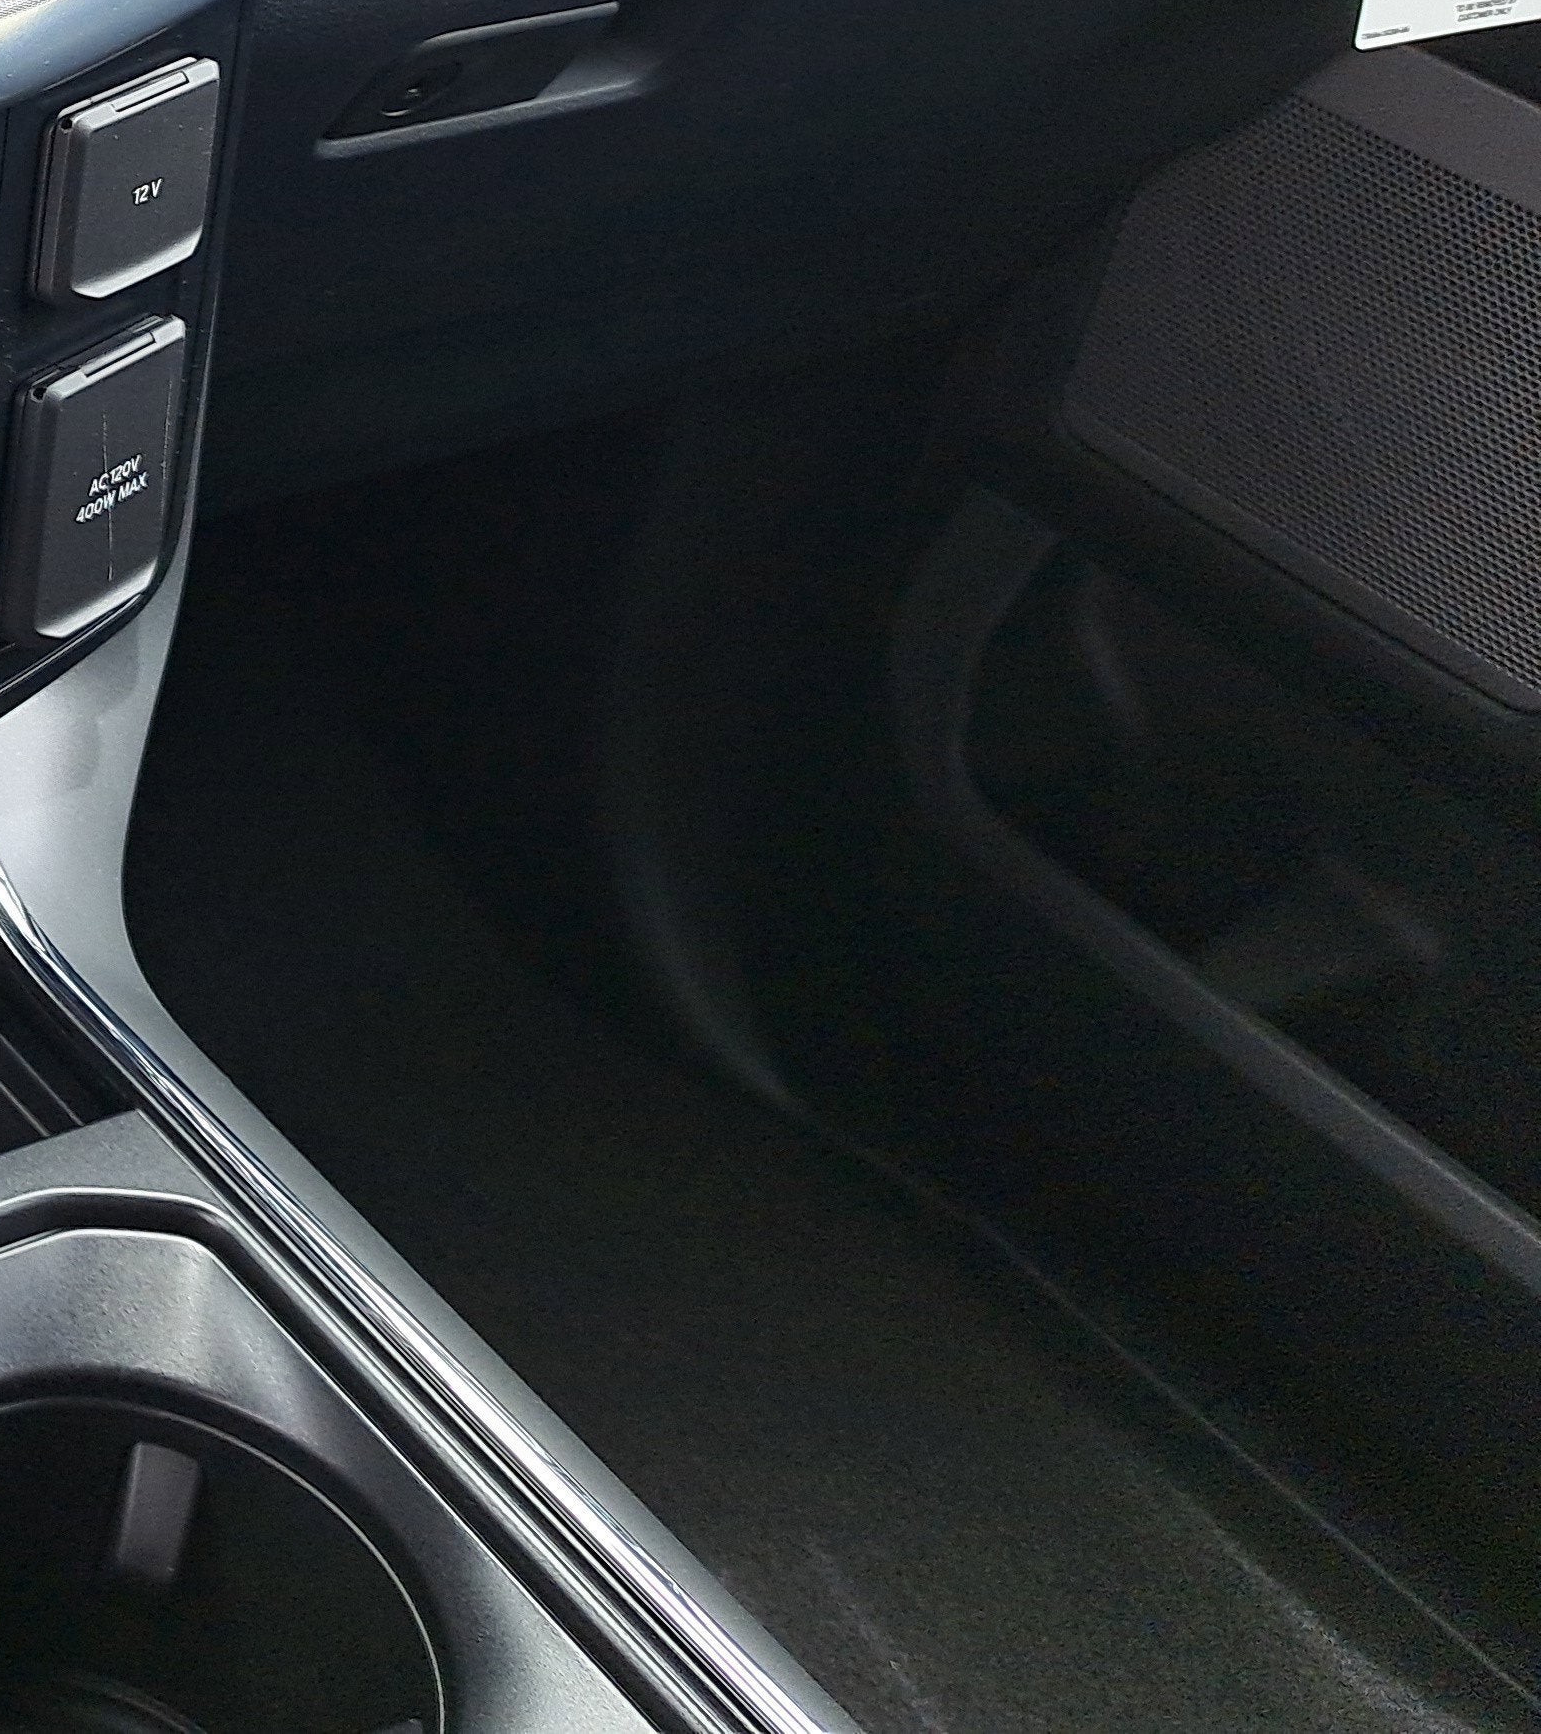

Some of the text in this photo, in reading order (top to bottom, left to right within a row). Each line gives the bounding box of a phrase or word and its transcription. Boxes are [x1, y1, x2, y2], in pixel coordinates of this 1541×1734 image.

[75, 471, 149, 523] 400W MAX
[88, 453, 142, 497] AC 120V
